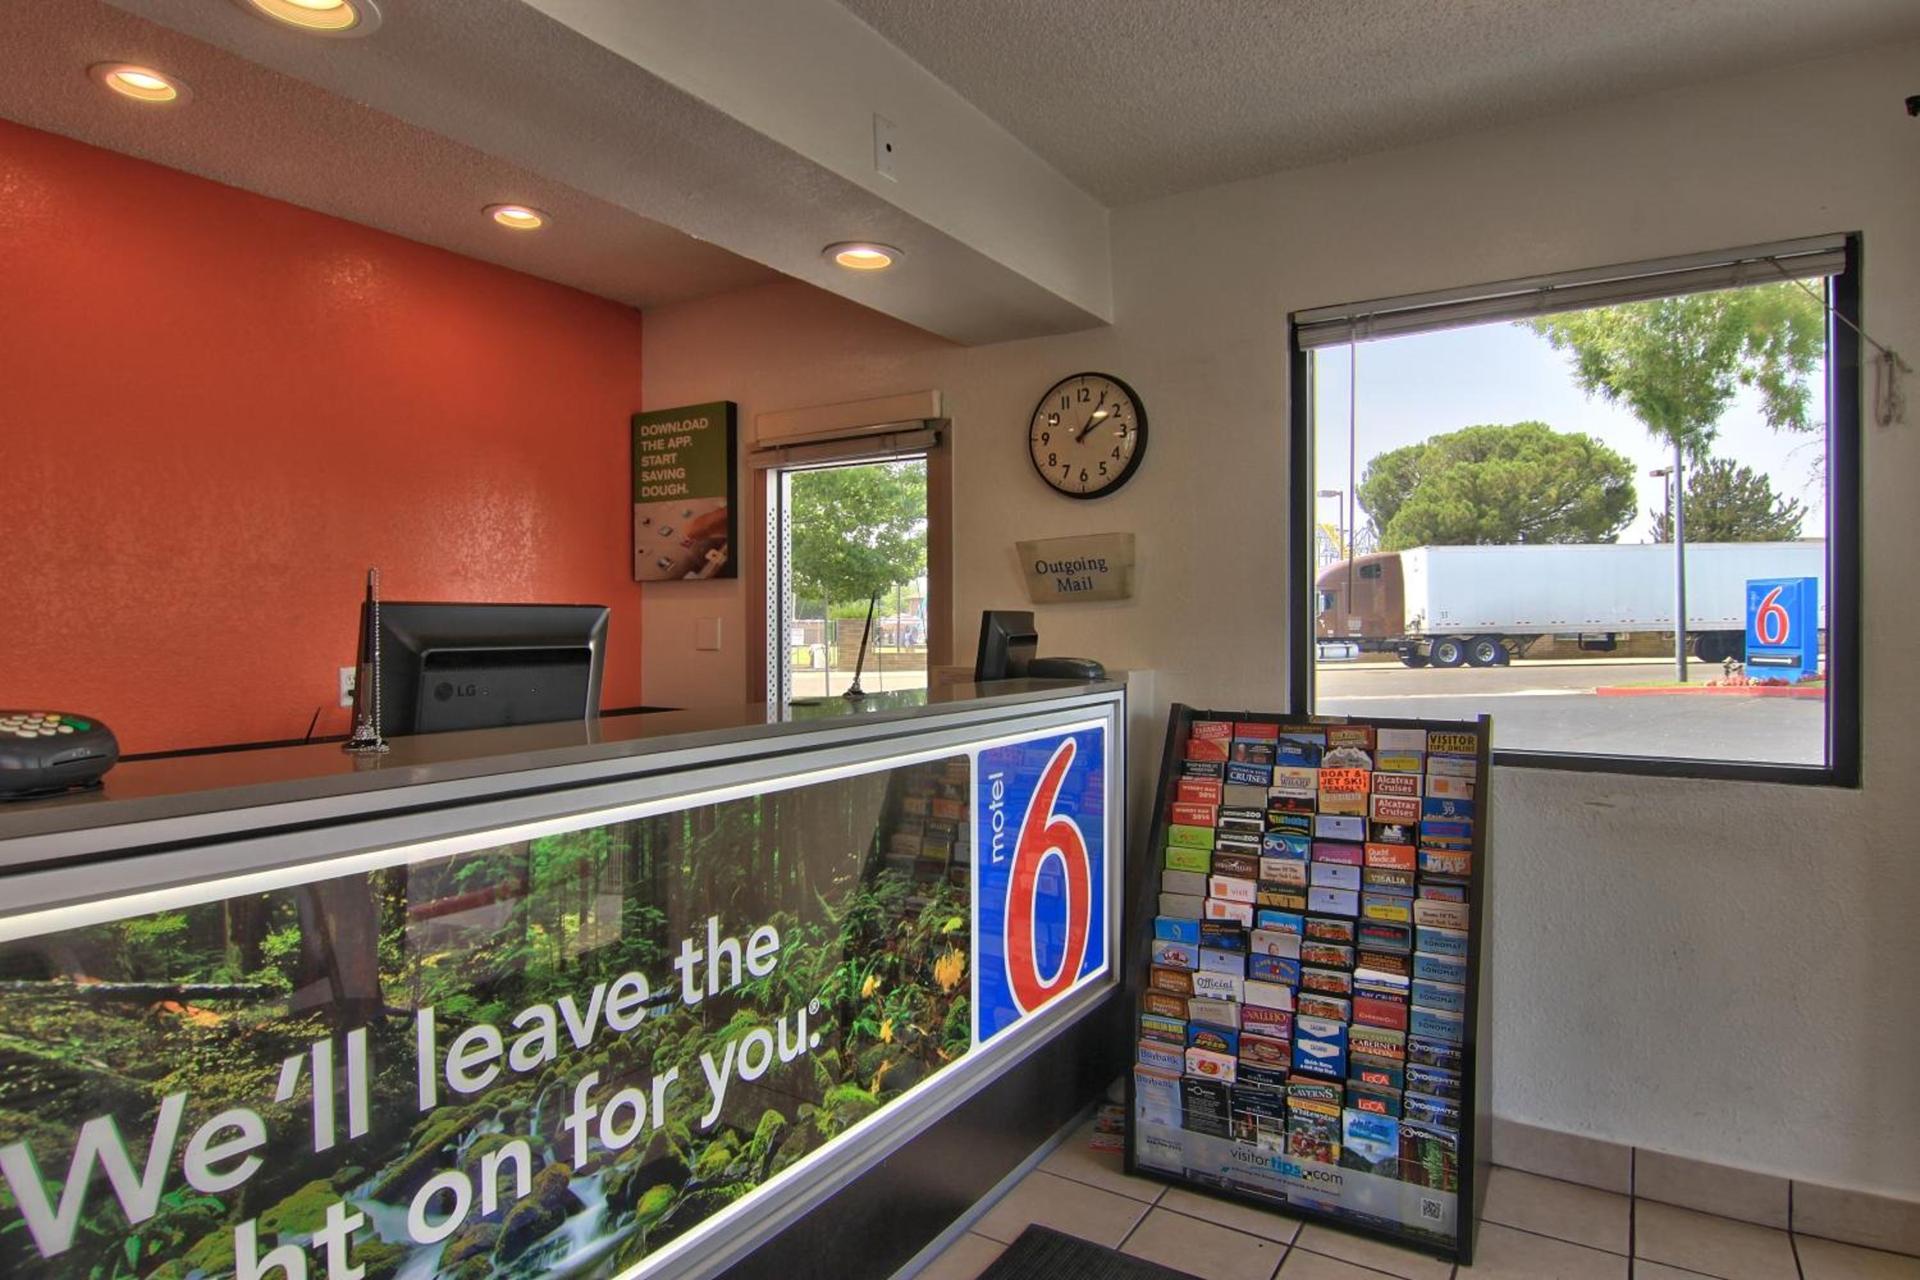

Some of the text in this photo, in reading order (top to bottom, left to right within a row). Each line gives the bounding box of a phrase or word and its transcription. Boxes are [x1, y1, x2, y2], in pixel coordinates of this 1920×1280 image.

[1077, 388, 1091, 403] 12
[1061, 396, 1070, 410] 11
[1112, 403, 1121, 418] 2
[641, 418, 709, 437] DOWNLOAD
[1119, 424, 1128, 438] 3
[641, 435, 693, 452] THE APP.
[1041, 432, 1050, 446] 9
[641, 453, 678, 467] START
[1048, 453, 1057, 467] 8
[1111, 446, 1121, 461] 4
[641, 467, 686, 482] SAVING
[1062, 465, 1071, 479] 7
[1079, 468, 1088, 482] 6
[1099, 461, 1108, 475] 5
[641, 483, 689, 497] DOUGH.
[1034, 556, 1109, 577] Outgoing
[1056, 576, 1093, 594] Mail
[1755, 585, 1790, 645] 6
[457, 684, 476, 697] LG
[1430, 735, 1475, 745] VISITOR
[1377, 775, 1414, 785] Alcatraz
[1379, 784, 1412, 793] Cruises
[1379, 799, 1416, 809] Alcatraz
[988, 772, 1004, 863] motel
[1380, 807, 1414, 816] Cruises
[1004, 737, 1091, 1018] 6
[1197, 978, 1233, 990] Official
[1352, 1039, 1396, 1052] CABERNET
[0, 917, 781, 1259] We'll leave the
[407, 1140, 531, 1246] on
[564, 1072, 680, 1170] for
